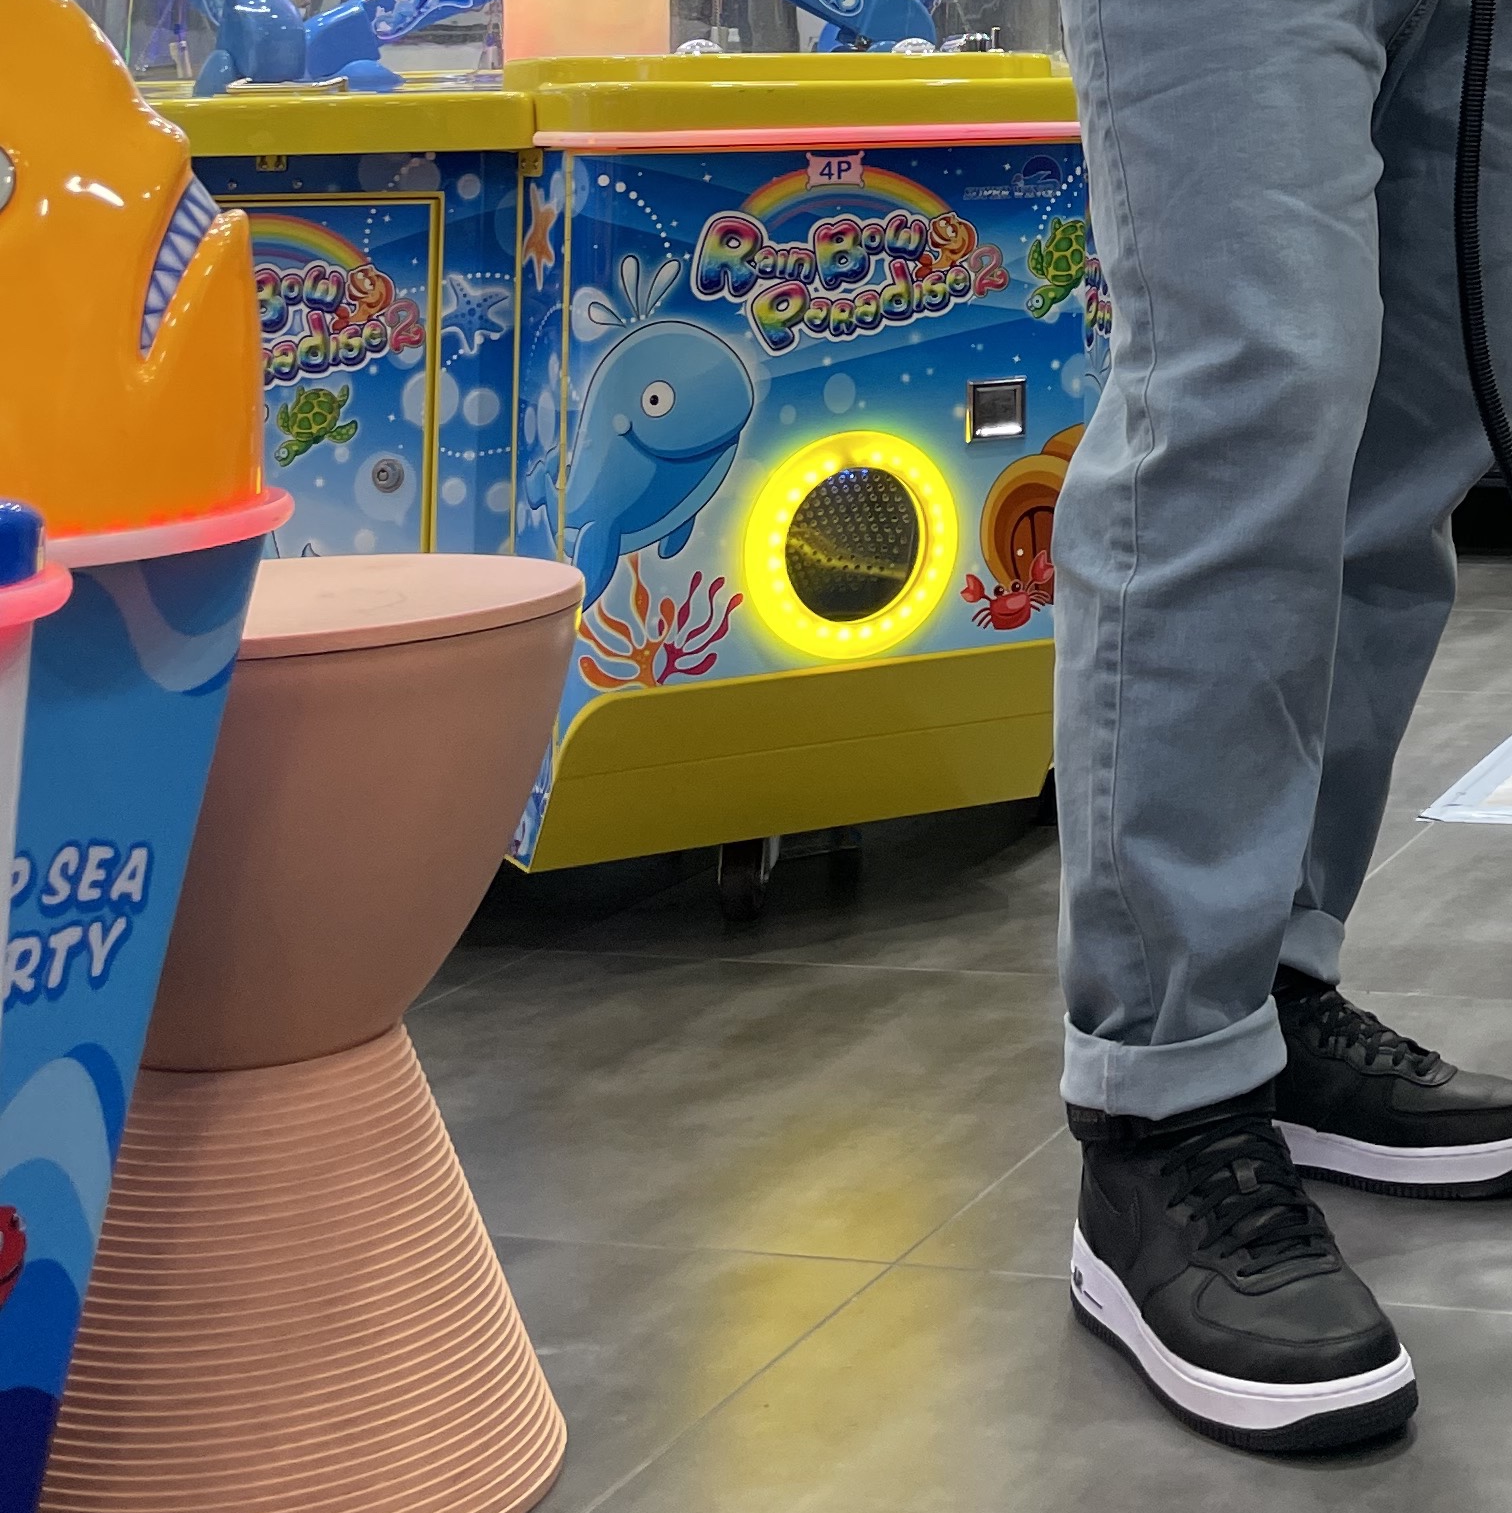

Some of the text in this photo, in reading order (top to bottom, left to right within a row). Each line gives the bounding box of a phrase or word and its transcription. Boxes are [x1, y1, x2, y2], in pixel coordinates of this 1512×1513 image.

[819, 159, 852, 181] 4P
[969, 242, 1009, 298] 2
[386, 299, 425, 353] 2
[42, 846, 148, 905] SEA
[6, 916, 127, 994] RTY
